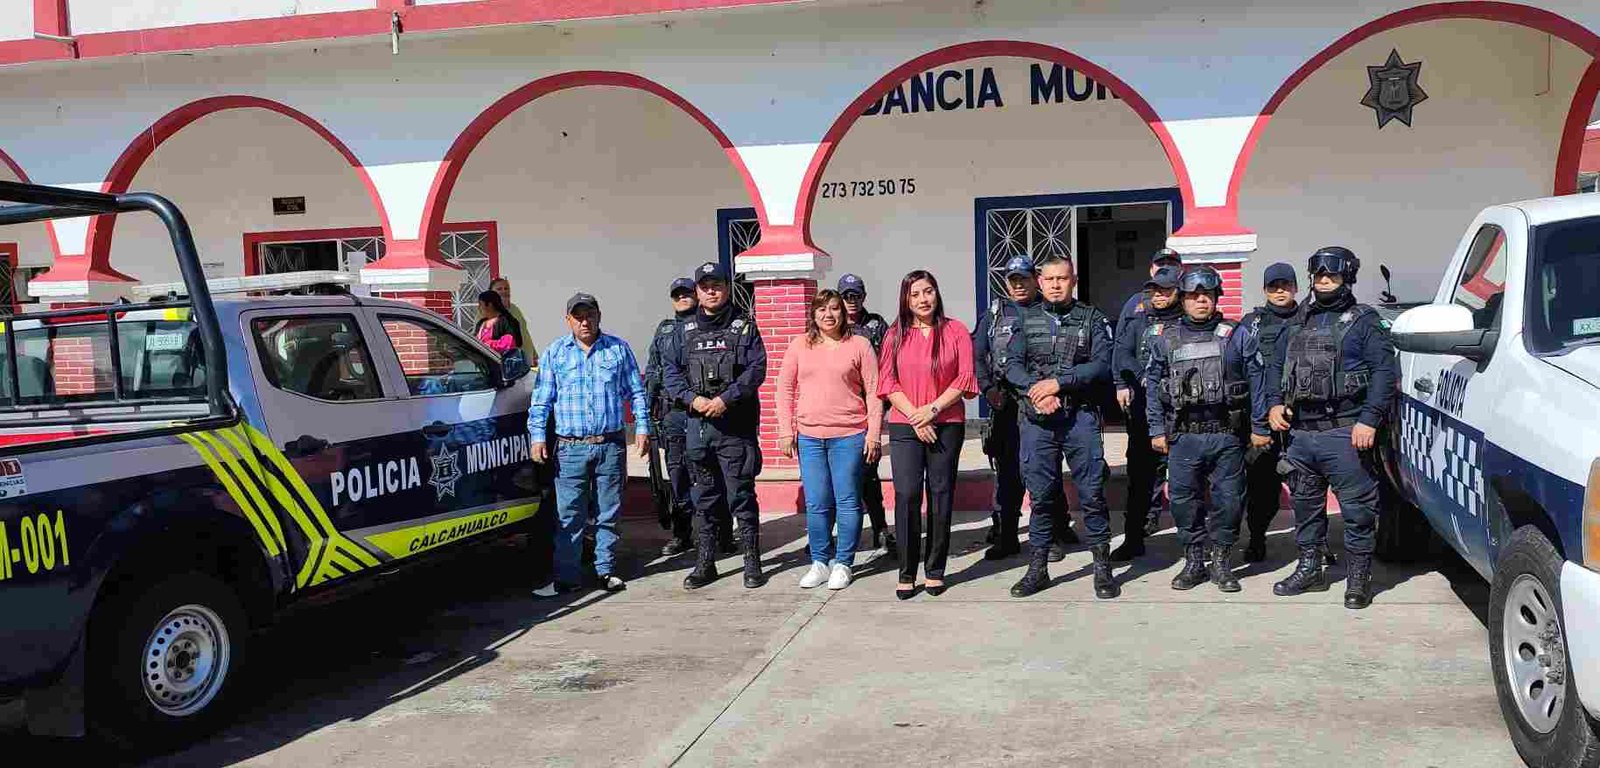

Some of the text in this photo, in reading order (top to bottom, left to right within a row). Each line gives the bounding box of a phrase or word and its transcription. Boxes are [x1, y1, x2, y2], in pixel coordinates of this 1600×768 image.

[822, 178, 916, 198] 273 732 50 75
[1434, 368, 1469, 419] POLICIA
[329, 456, 422, 506] POLICIA
[408, 511, 508, 552] CALCAHUALCO
